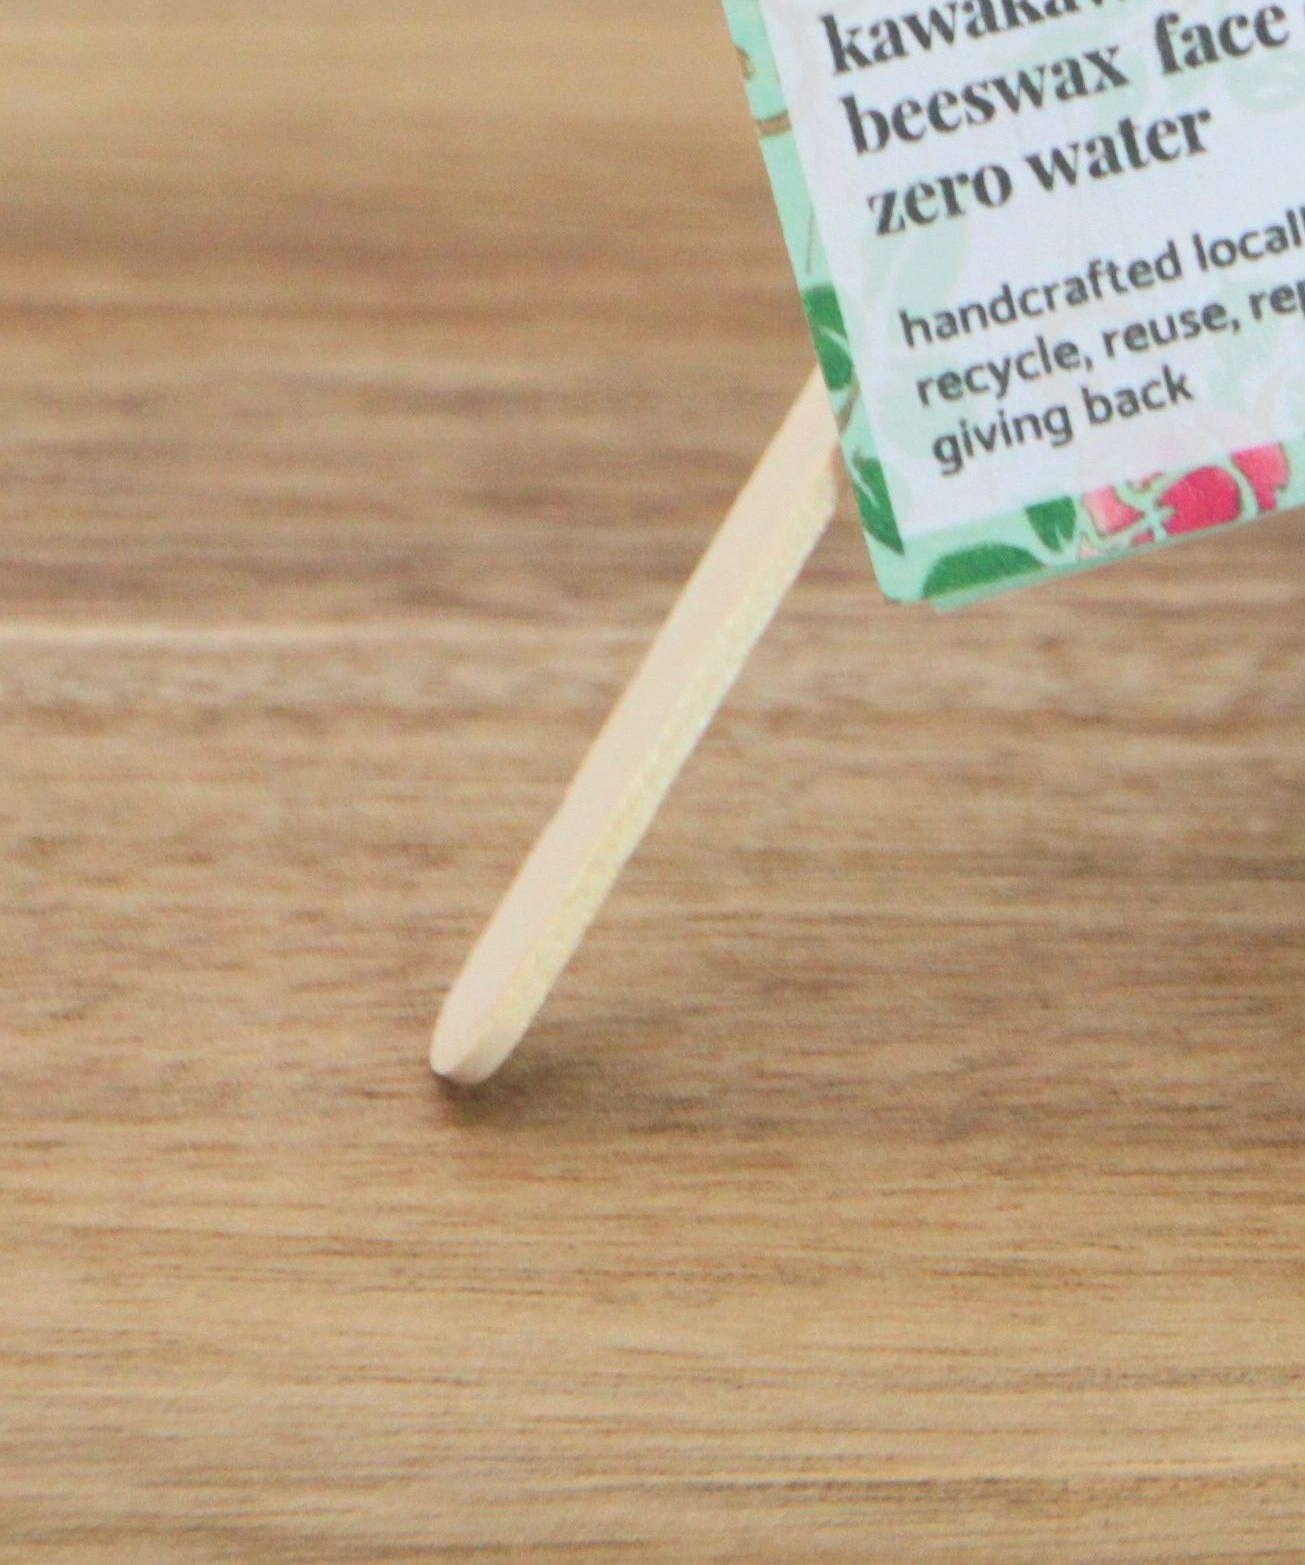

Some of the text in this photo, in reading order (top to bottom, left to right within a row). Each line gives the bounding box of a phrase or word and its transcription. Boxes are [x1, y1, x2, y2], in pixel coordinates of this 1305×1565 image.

[840, 45, 1131, 156] beeswax
[1152, 5, 1289, 76] face
[868, 108, 1212, 237] zero water
[898, 240, 1184, 349] handcrafted
[914, 335, 1094, 408] recycle,
[1102, 302, 1242, 359] reuse,
[931, 364, 1194, 476] giving back
